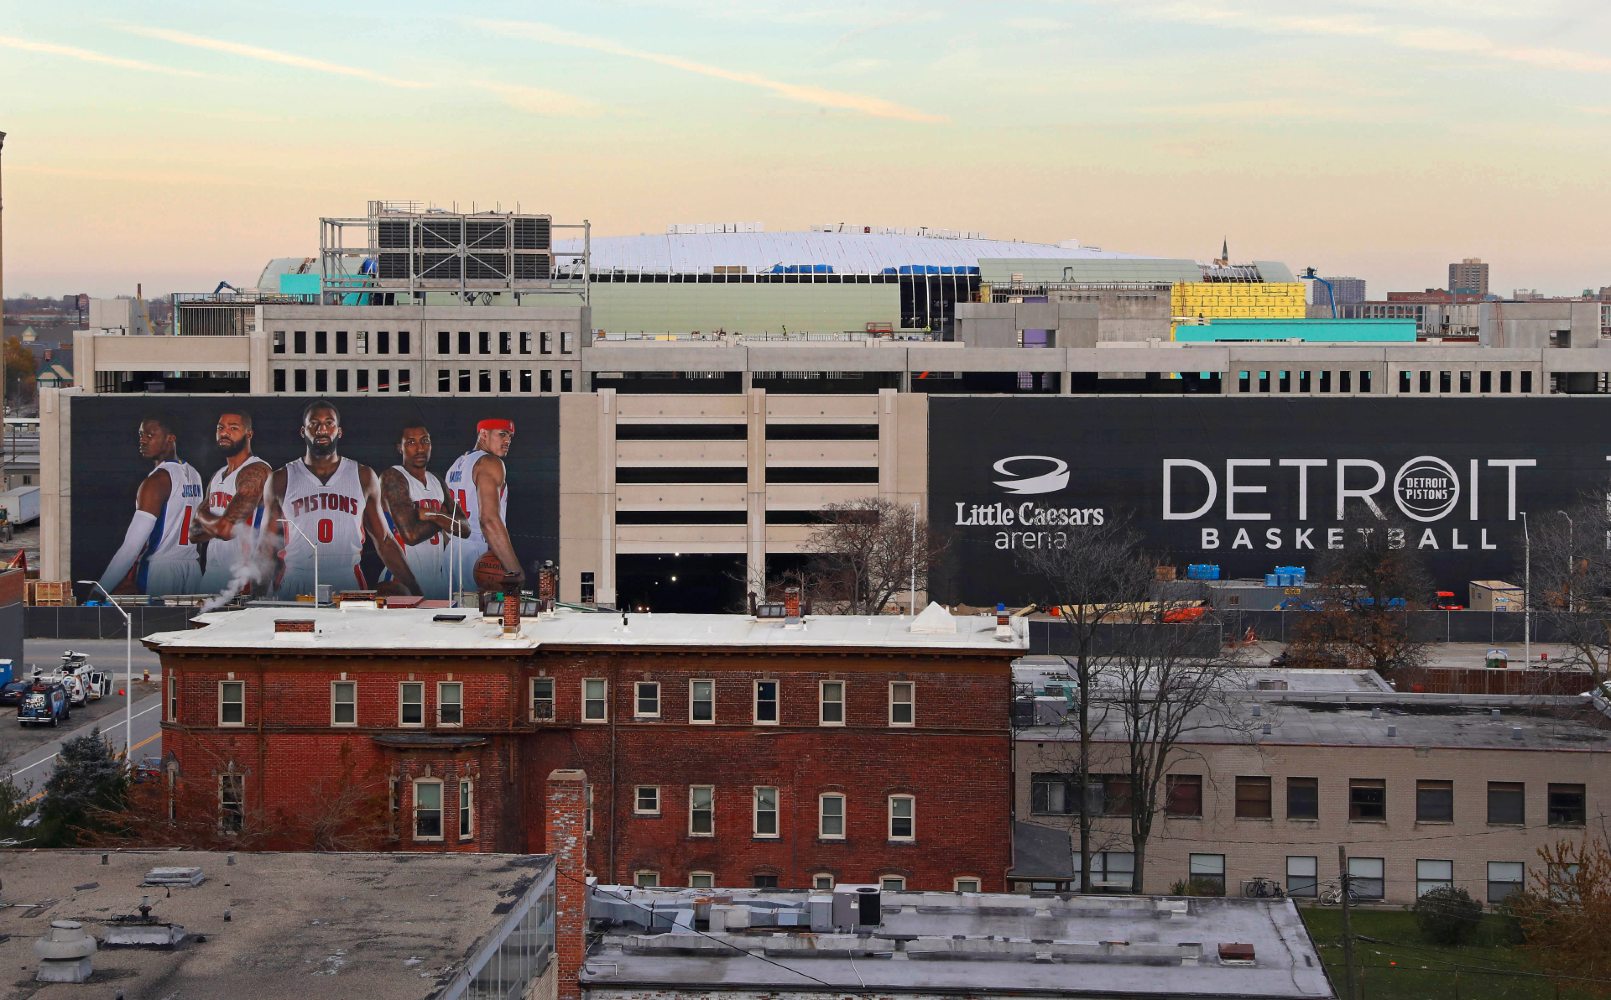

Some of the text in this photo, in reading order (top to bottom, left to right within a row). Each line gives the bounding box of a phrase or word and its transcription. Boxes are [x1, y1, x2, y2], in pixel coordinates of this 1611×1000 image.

[1163, 456, 1537, 522] DETROIT
[1405, 489, 1448, 500] PISTONS
[1406, 478, 1447, 488] DETROIT
[291, 493, 358, 517] PISTONS
[955, 502, 1105, 526] Little Caesars
[179, 505, 193, 546] 1
[317, 519, 334, 544] 0
[995, 531, 1067, 550] arena
[1201, 528, 1497, 549] BASKETBALL
